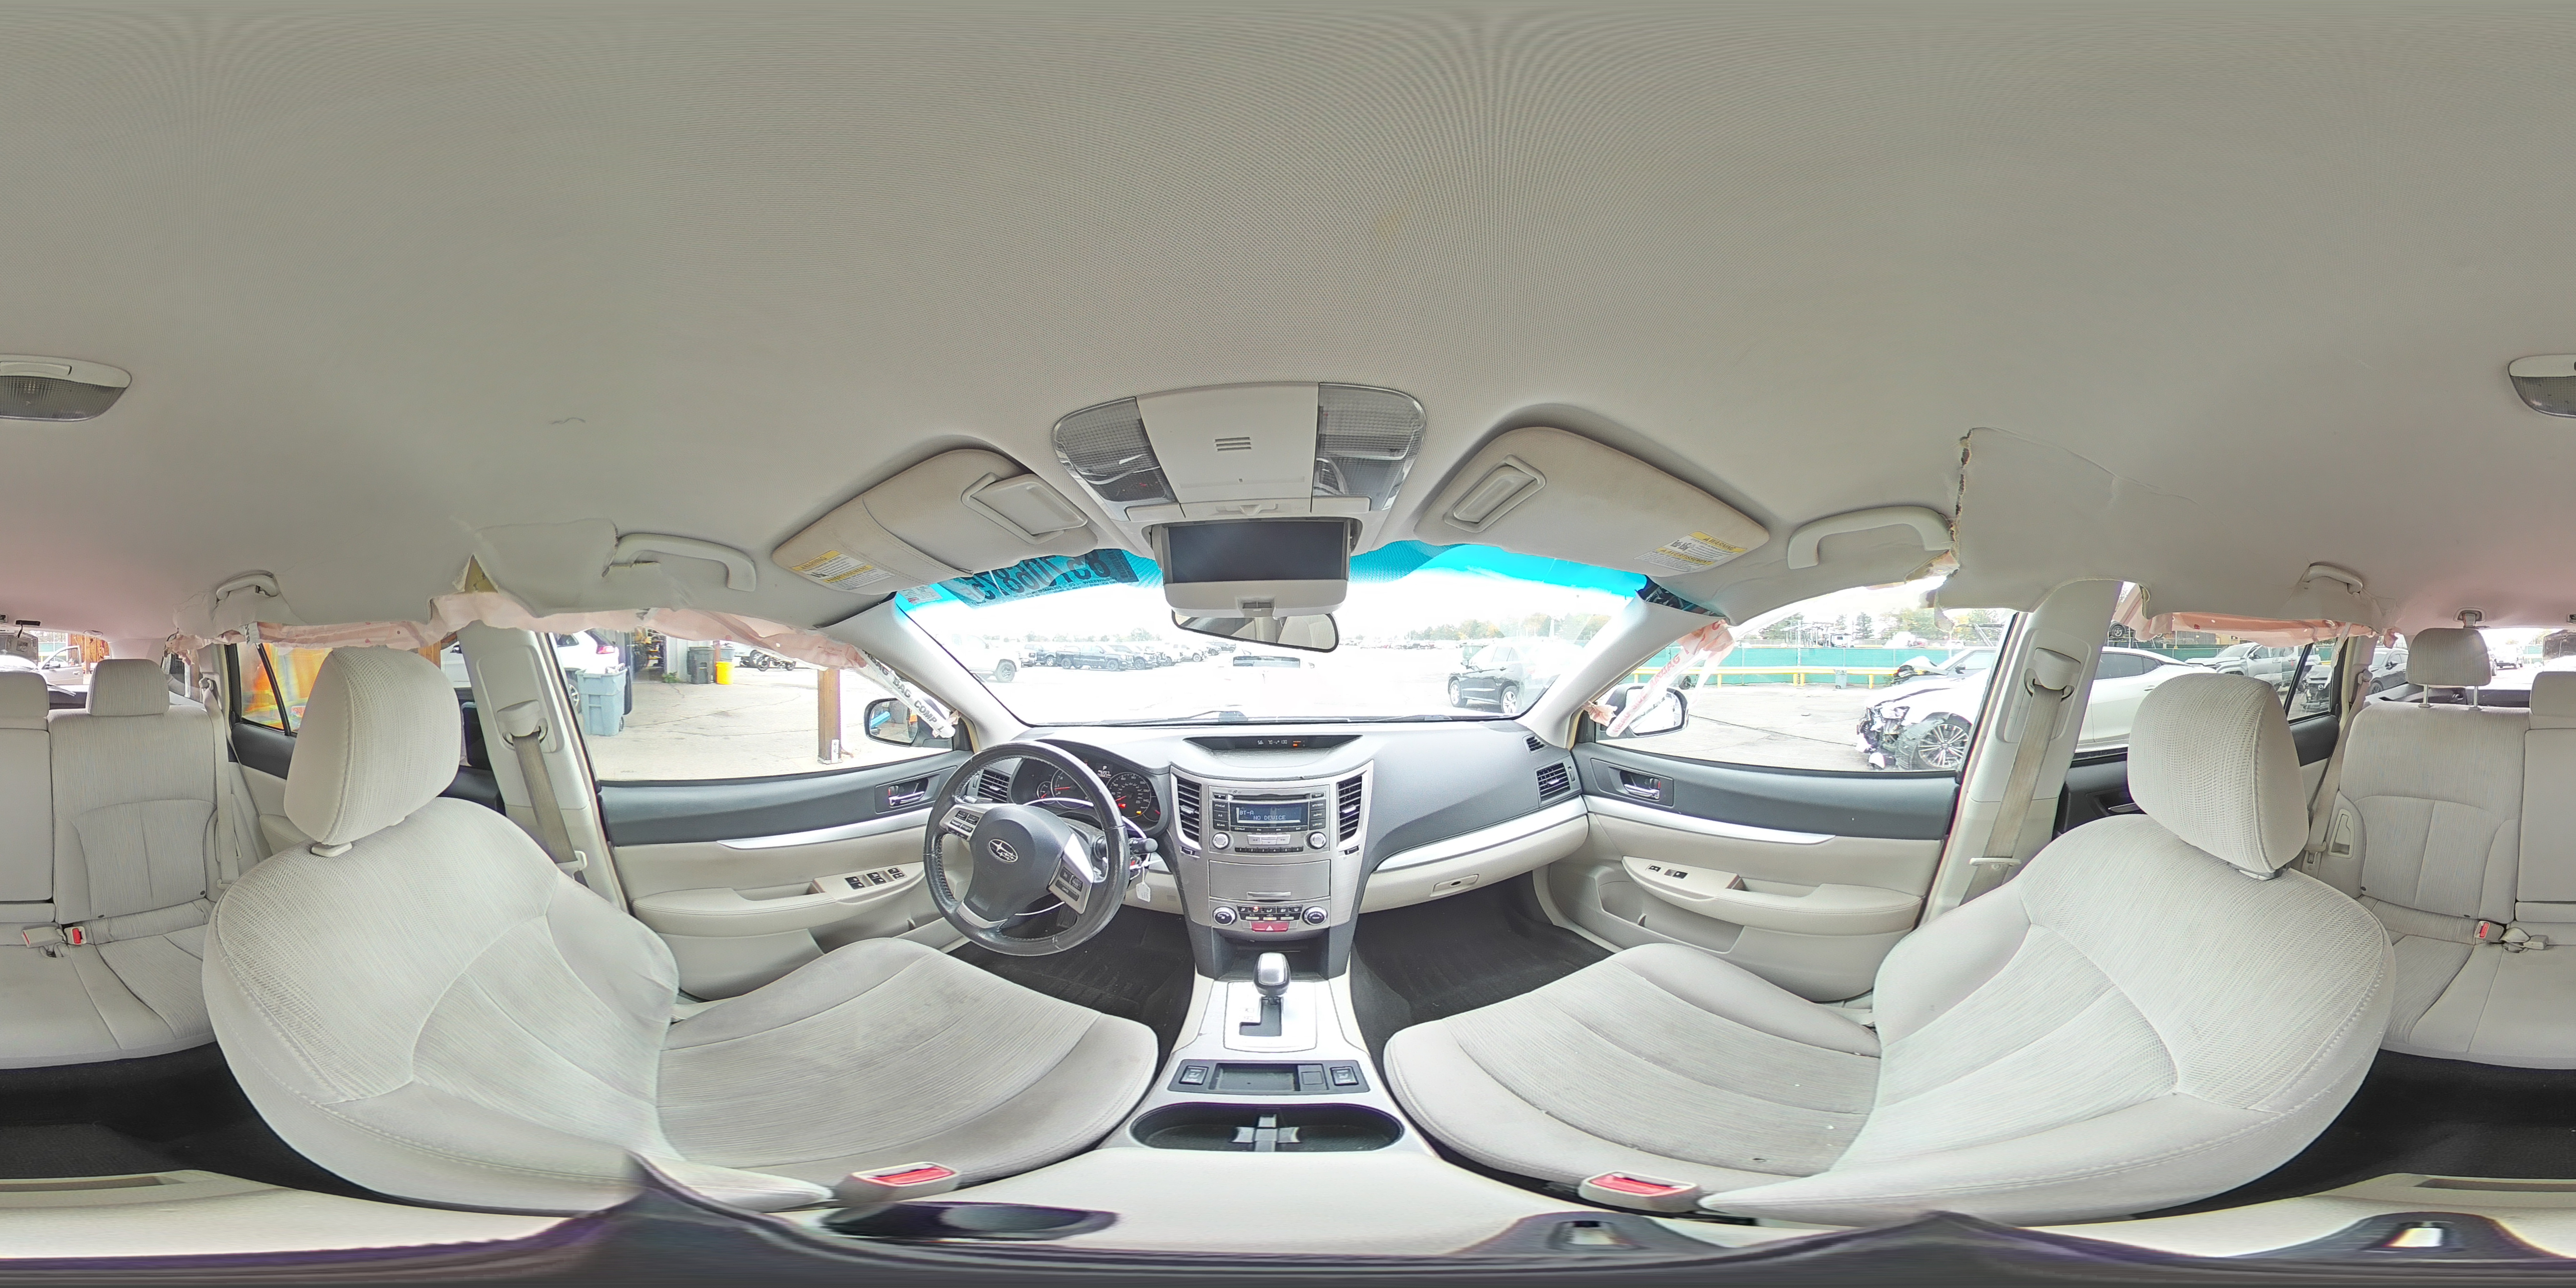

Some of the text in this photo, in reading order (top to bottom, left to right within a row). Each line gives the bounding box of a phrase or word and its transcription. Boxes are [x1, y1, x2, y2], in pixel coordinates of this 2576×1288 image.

[1709, 538, 1736, 551] WARNING
[803, 556, 828, 568] WARNING
[1649, 654, 1681, 690] AIRBAG
[892, 677, 912, 698] BAG
[914, 699, 938, 723] COMP
